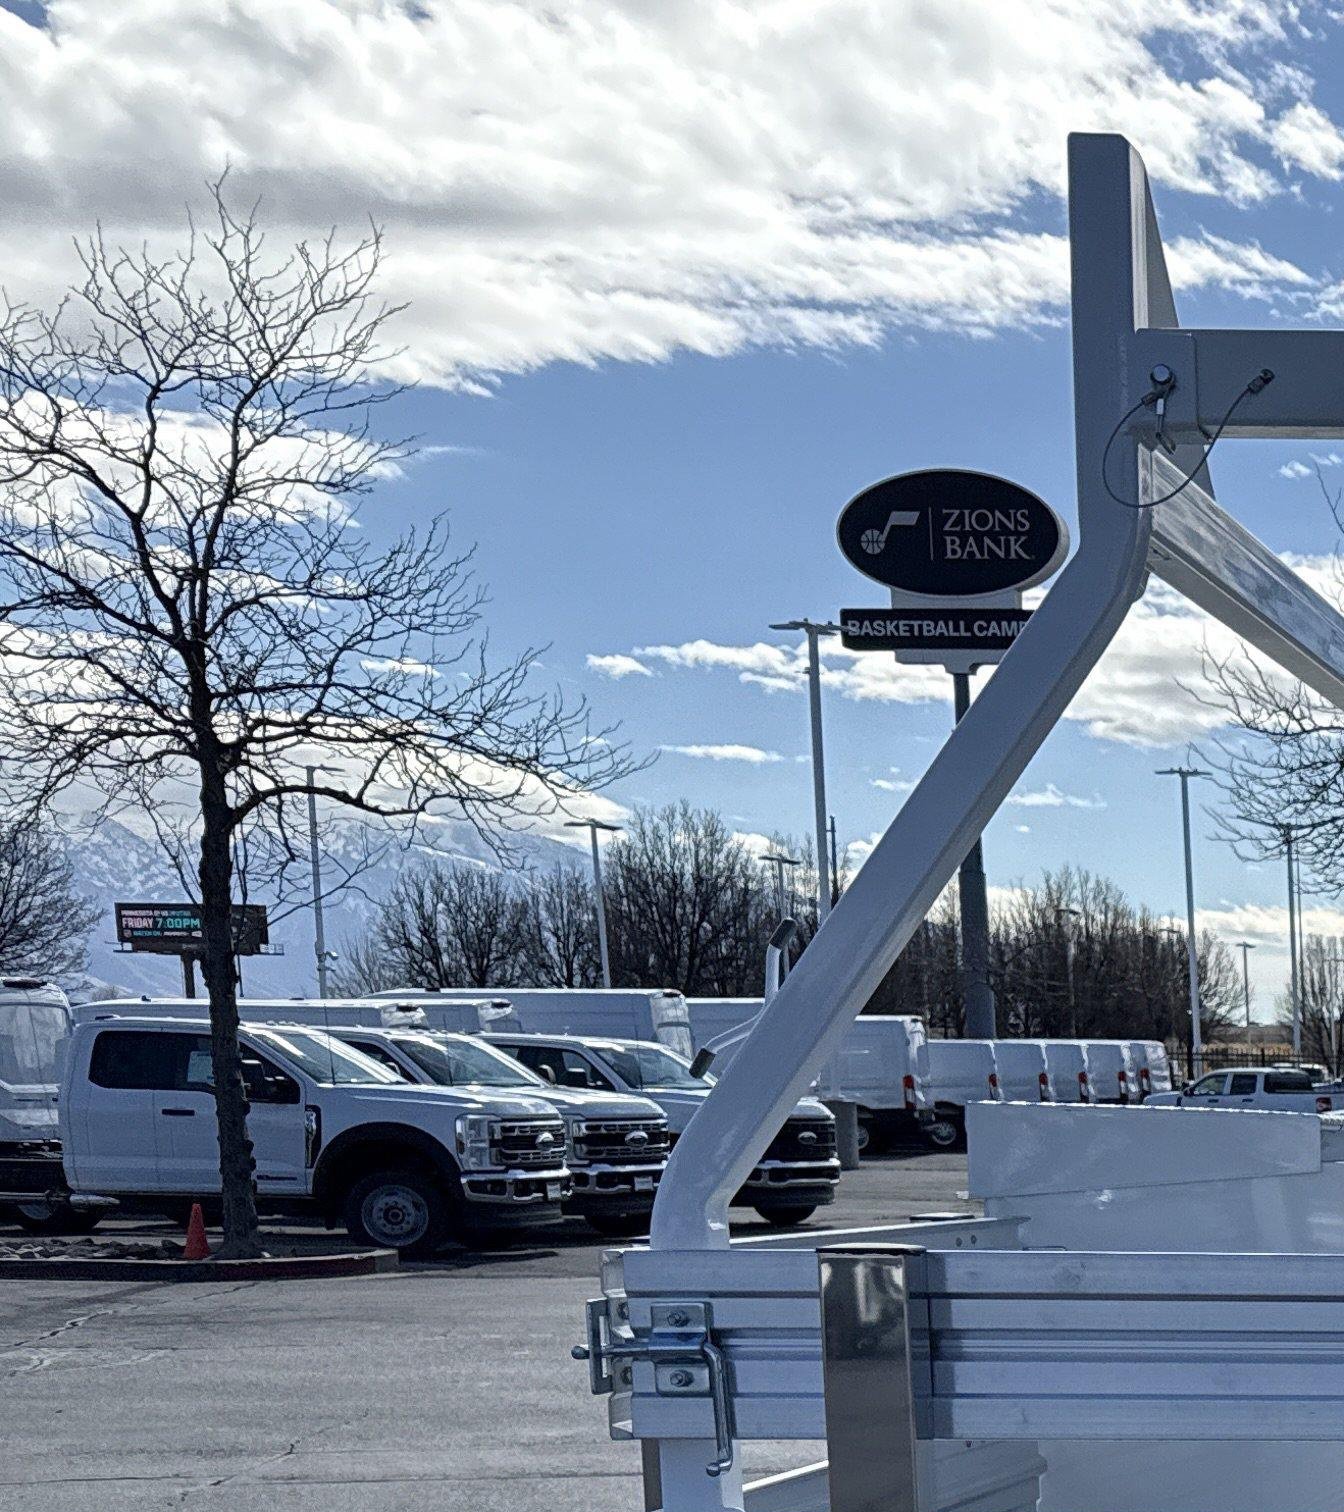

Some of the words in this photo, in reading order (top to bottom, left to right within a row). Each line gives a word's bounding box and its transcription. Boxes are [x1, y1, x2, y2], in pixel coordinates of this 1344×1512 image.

[942, 509, 1030, 532] ZIONS
[847, 620, 970, 637] BASKETBALL
[122, 917, 154, 928] FRIDAY
